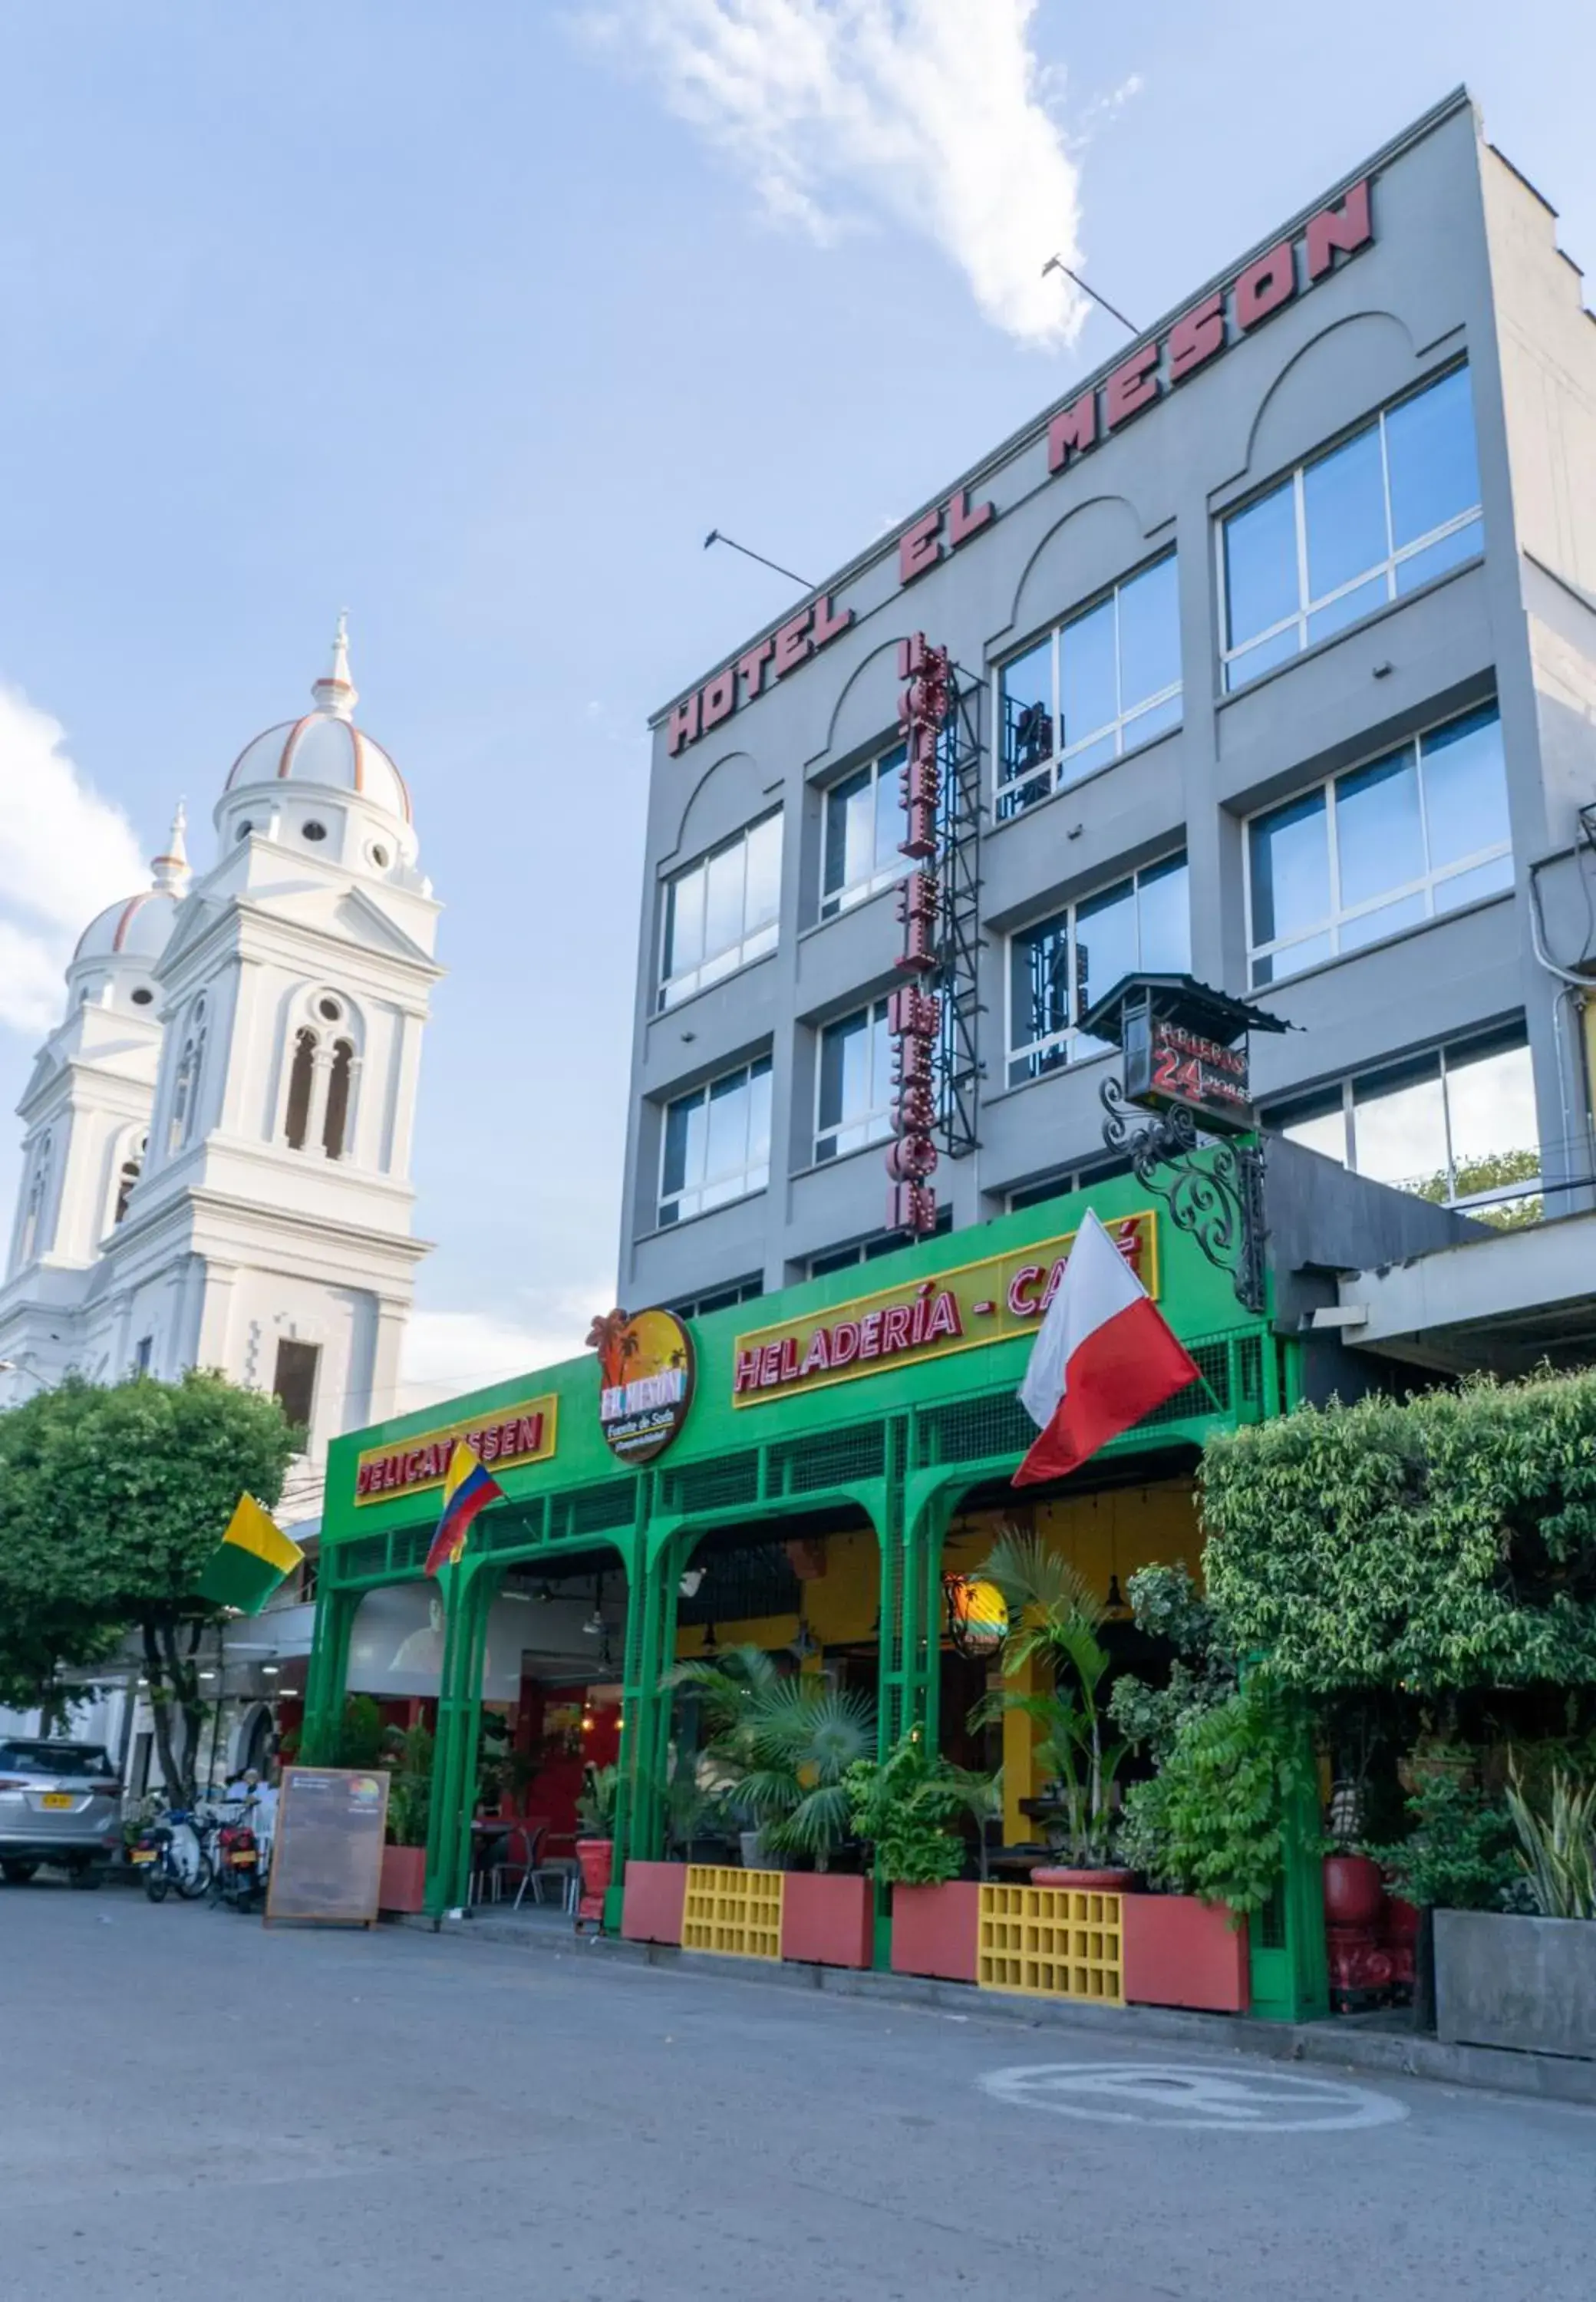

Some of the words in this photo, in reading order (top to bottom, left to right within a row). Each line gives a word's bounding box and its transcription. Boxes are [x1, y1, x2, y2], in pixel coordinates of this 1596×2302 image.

[667, 594, 854, 758] HOTEL
[899, 489, 995, 587] EL
[1047, 178, 1372, 476] MESON
[1153, 1047, 1207, 1103] 24
[734, 1281, 964, 1393] HELADERÍA
[355, 1412, 544, 1496] DELICATSSEN
